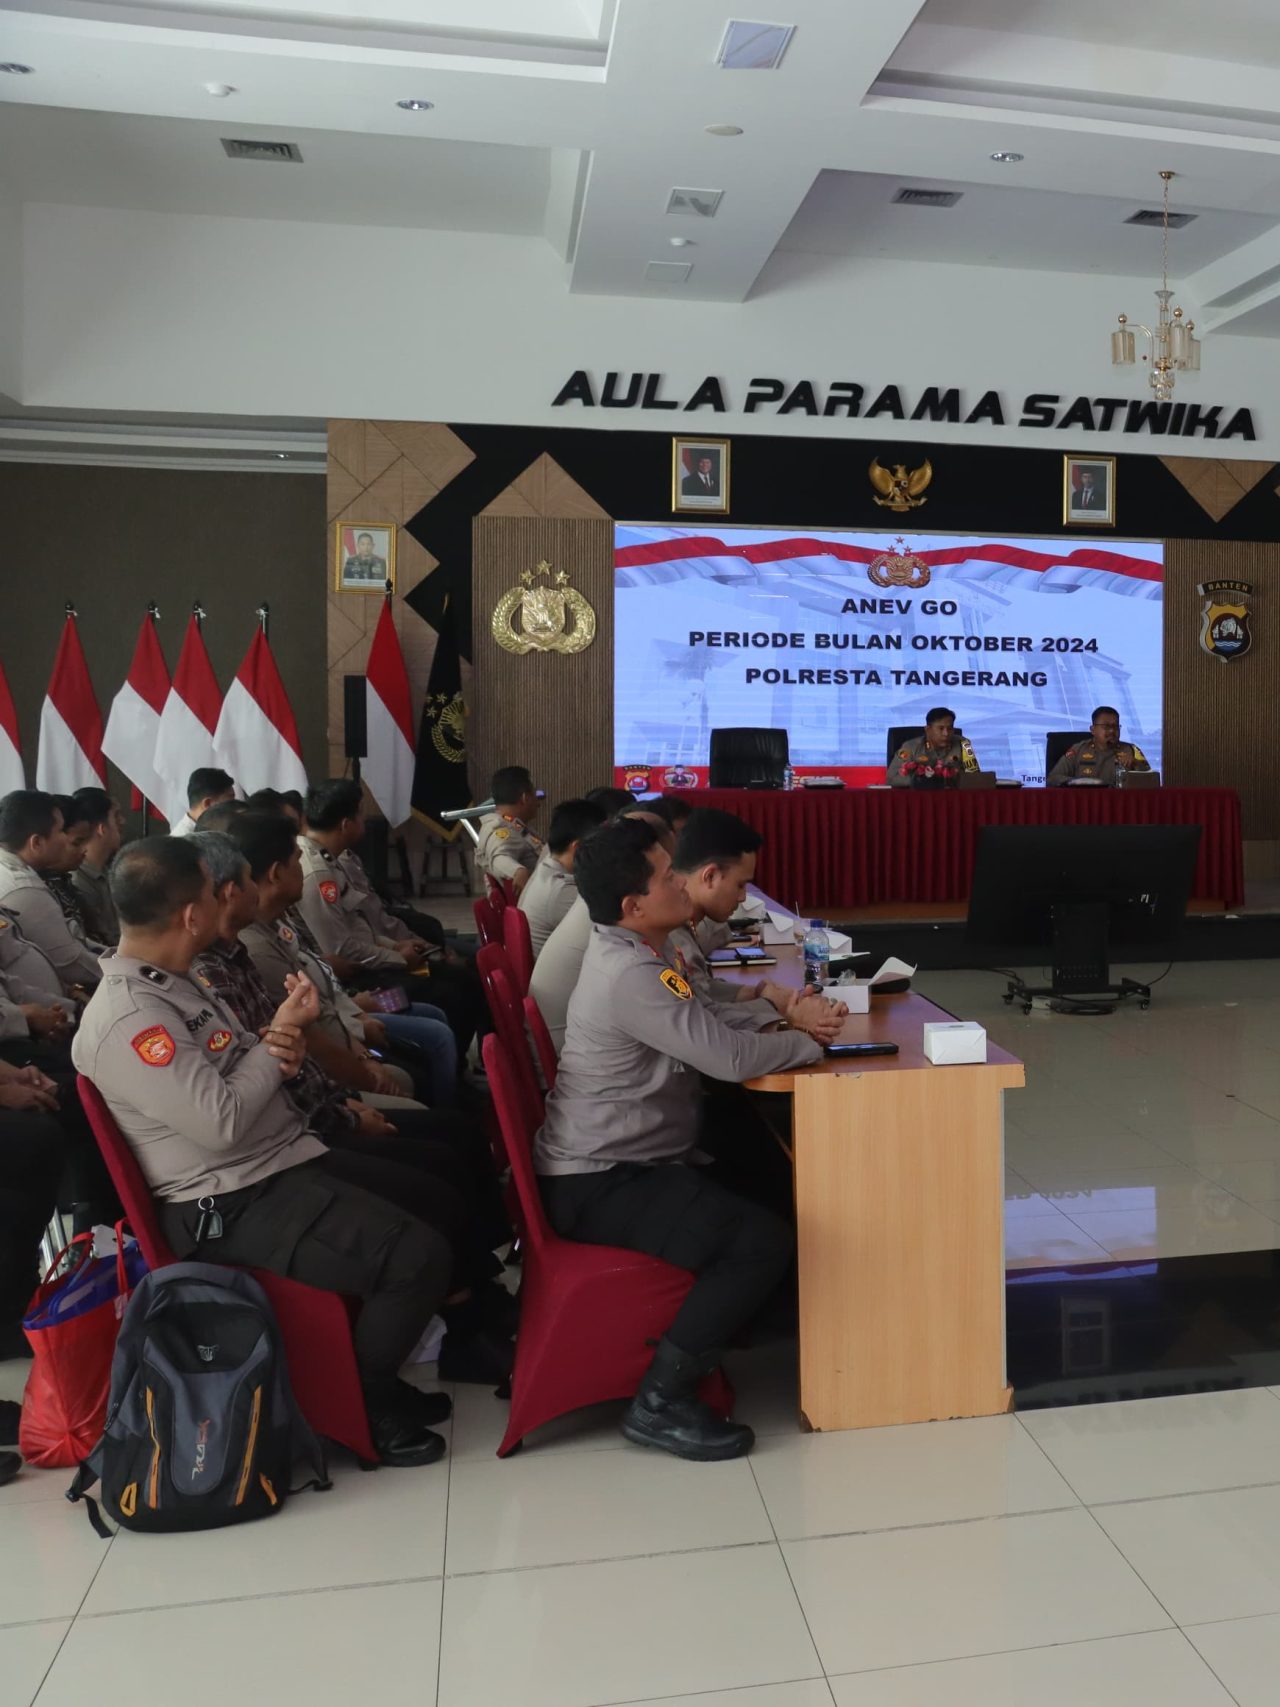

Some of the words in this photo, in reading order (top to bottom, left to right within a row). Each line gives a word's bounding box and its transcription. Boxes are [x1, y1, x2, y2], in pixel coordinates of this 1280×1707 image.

[552, 370, 726, 413] AULA
[743, 378, 1005, 427] PARAMA
[1018, 393, 1258, 442] SATWIKA
[1208, 582, 1248, 592] BANTEN
[841, 599, 913, 615] ANEV
[920, 600, 958, 616] GO
[689, 631, 805, 649] PERIODE
[814, 633, 902, 650] BULAN
[911, 635, 1033, 652] OKTOBER
[1041, 637, 1099, 653] 2024
[746, 668, 882, 685] POLRESTA
[890, 670, 1048, 688] TANGERANG
